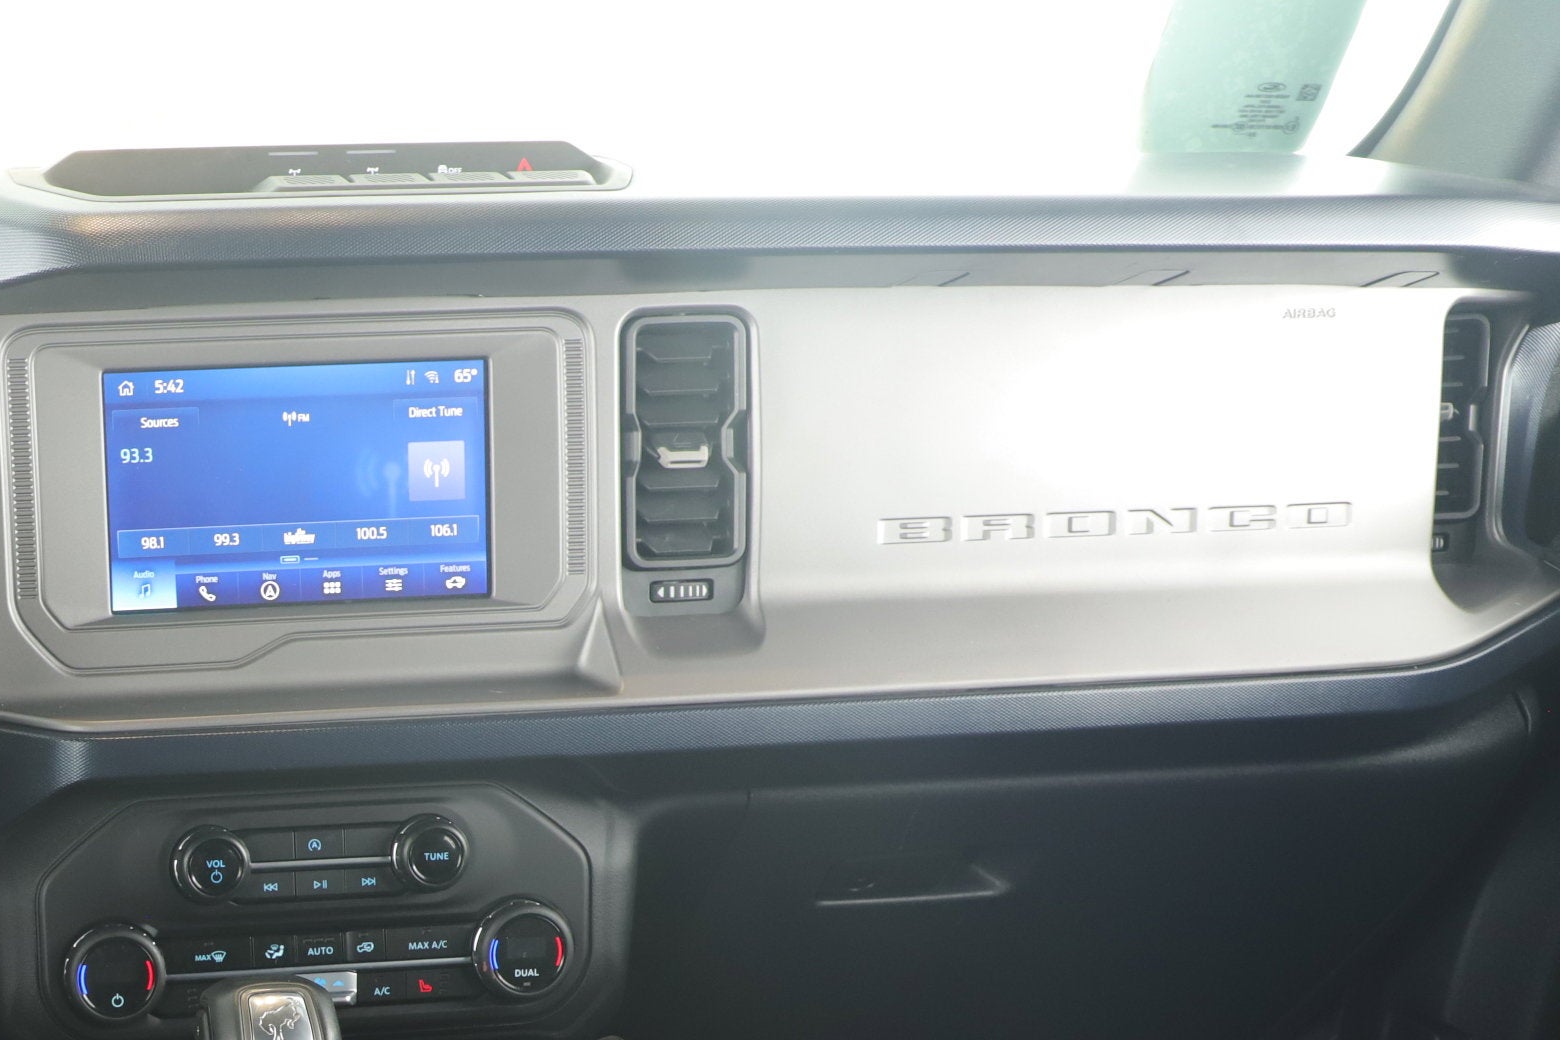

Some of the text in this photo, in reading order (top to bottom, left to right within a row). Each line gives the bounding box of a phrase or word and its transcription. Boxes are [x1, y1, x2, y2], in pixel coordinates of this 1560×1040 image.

[1282, 307, 1336, 320] AIRBAG
[453, 368, 478, 384] 65°
[154, 378, 184, 395] 5:42
[297, 412, 310, 423] FM
[408, 405, 463, 419] Direct Tune
[140, 416, 179, 430] Sources
[120, 448, 153, 464] 93.3
[356, 527, 387, 540] 100.5
[430, 524, 457, 537] 106.1
[141, 537, 164, 550] 98.1
[214, 533, 240, 546] 99.3
[378, 565, 408, 578] Settings
[440, 563, 471, 573] Features
[133, 569, 155, 579] Audio
[195, 575, 218, 584] Phone
[262, 571, 277, 581] Nav
[323, 568, 341, 580] Apps
[424, 852, 449, 861] TUNE
[206, 859, 226, 868] VOL
[408, 940, 448, 950] MAX A/C
[307, 946, 334, 956] AUTO
[195, 954, 212, 962] MAX
[514, 969, 539, 977] DUAL
[374, 987, 390, 996] A/C
